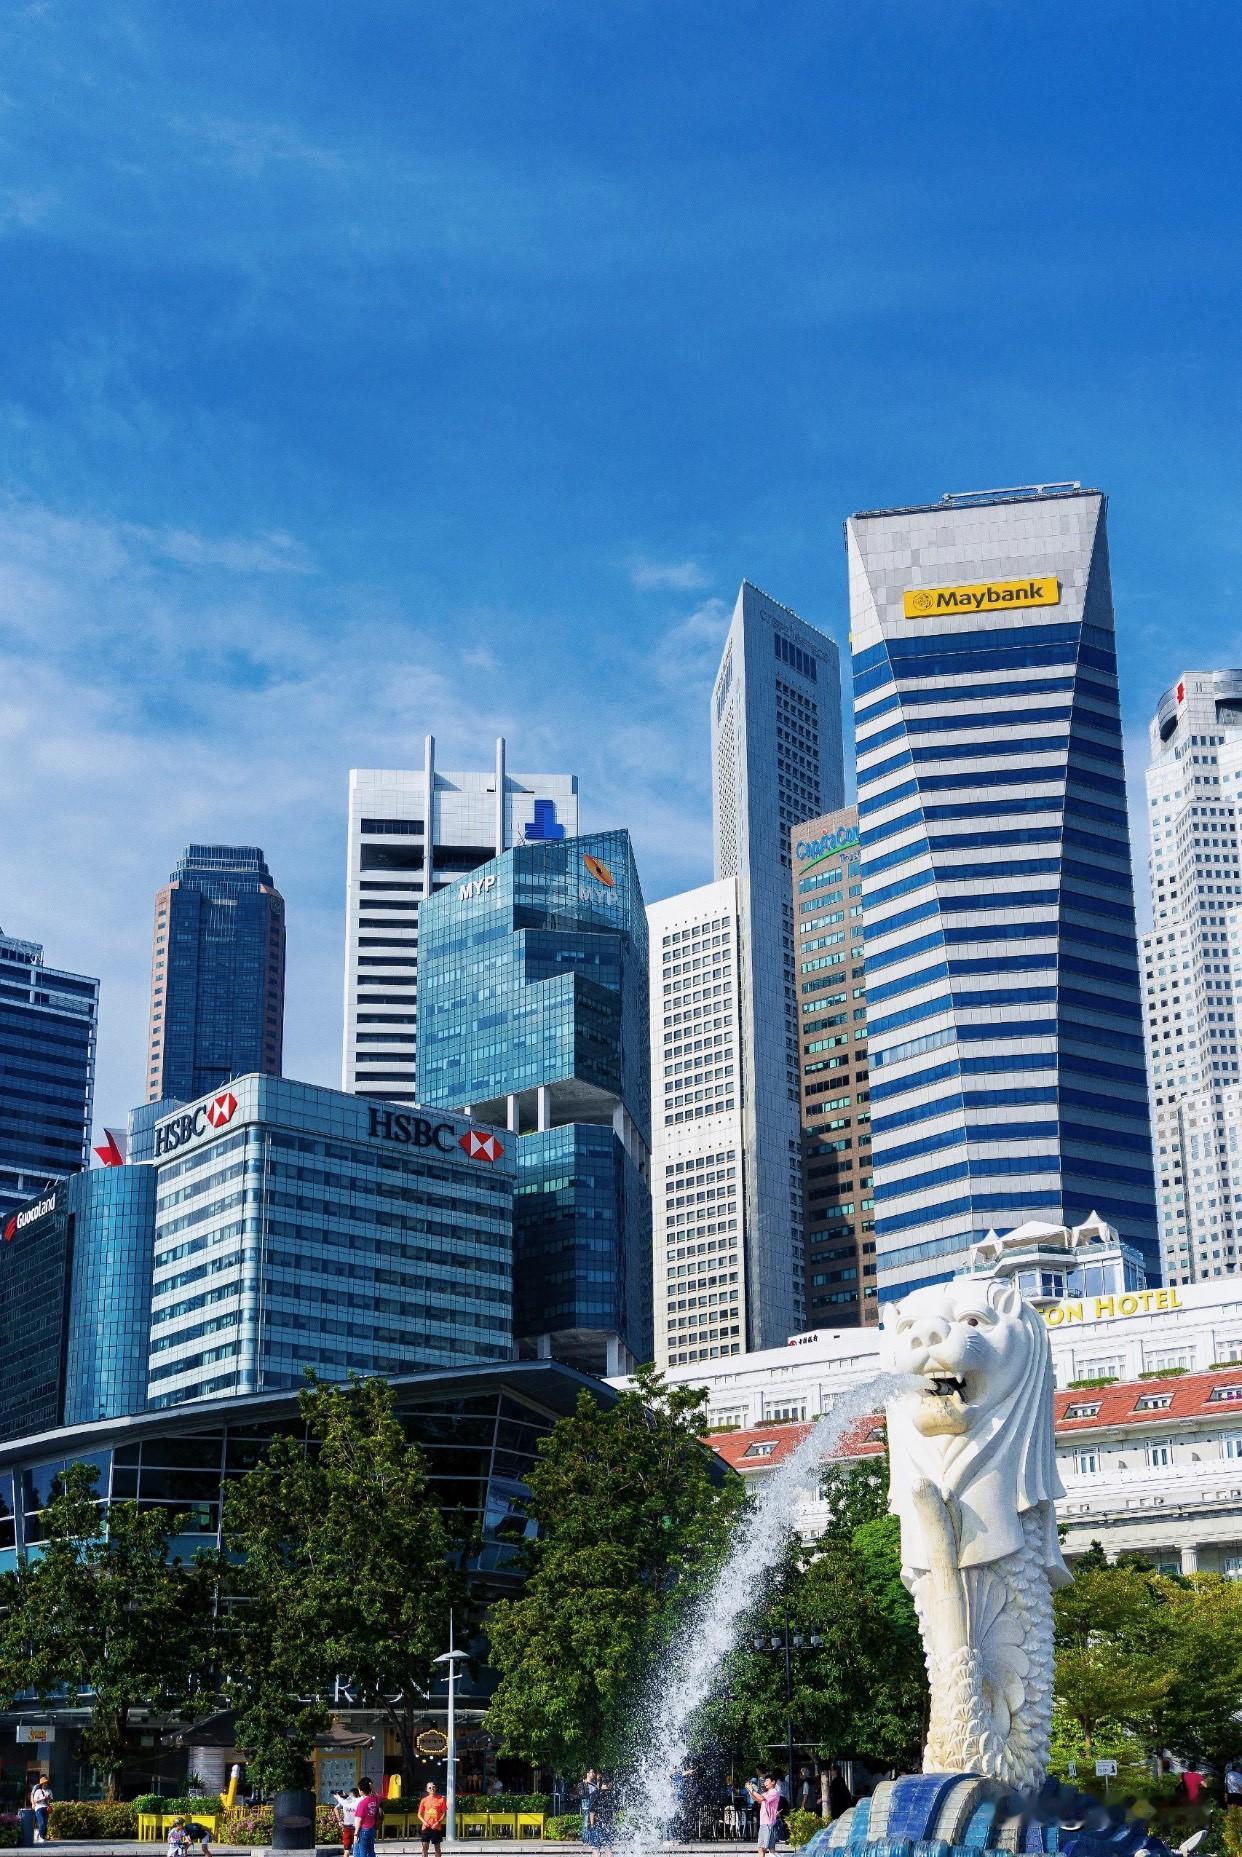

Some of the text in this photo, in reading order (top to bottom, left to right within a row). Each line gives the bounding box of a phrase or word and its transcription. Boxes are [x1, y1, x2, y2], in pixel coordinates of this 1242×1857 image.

[936, 582, 1044, 609] Maybank
[459, 874, 496, 900] MYP
[579, 885, 617, 905] MYP
[154, 1104, 207, 1157] HSBC
[368, 1106, 455, 1152] HSBC
[16, 1193, 56, 1229] GuocoLand
[1095, 1288, 1183, 1319] HOTEL
